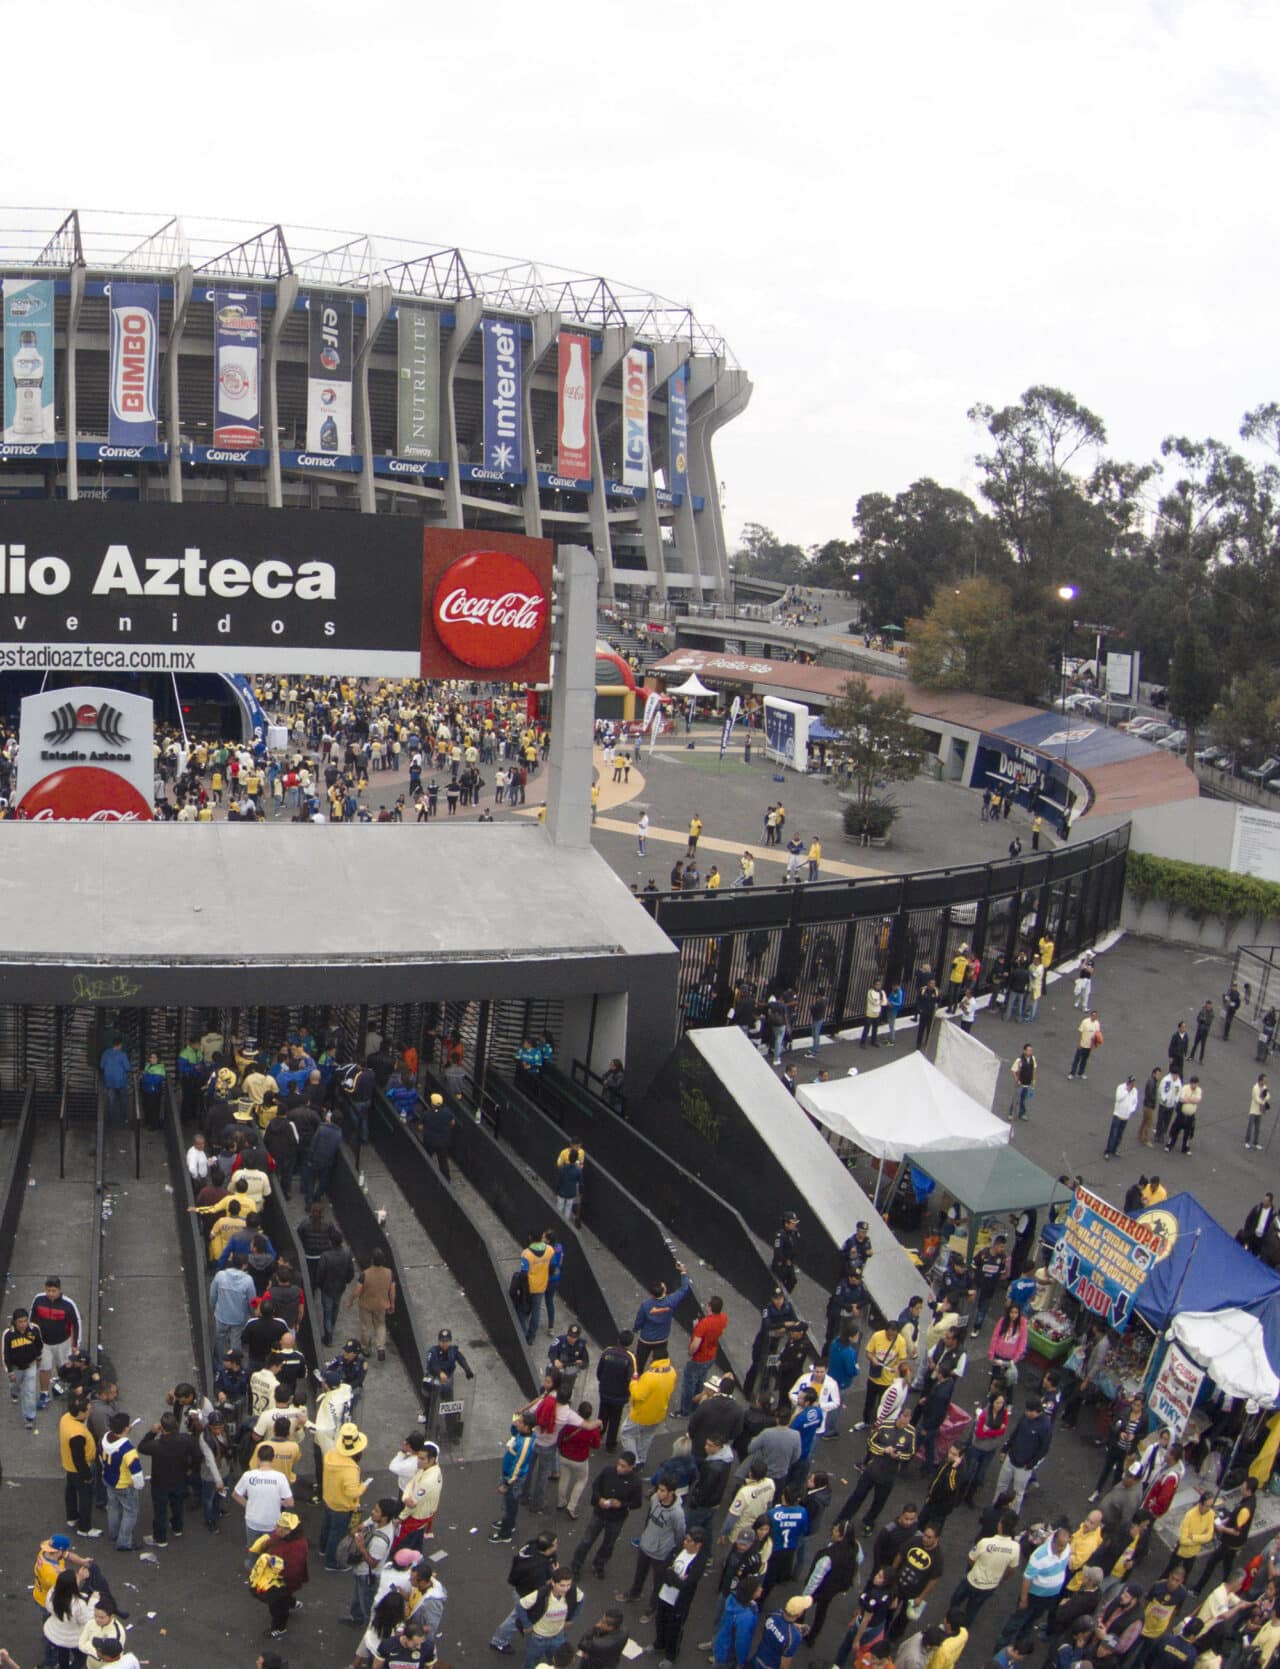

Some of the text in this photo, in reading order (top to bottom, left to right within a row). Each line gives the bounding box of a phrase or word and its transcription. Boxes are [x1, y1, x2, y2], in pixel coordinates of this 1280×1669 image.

[122, 314, 146, 413] BIMBO
[413, 316, 426, 439] NUTRILITE
[98, 445, 146, 458] Comex
[206, 449, 250, 462] Comex
[297, 454, 339, 467] Comex
[389, 460, 429, 473] Comex
[471, 467, 505, 481] Comex
[547, 474, 578, 488] Comex
[611, 483, 636, 496] Comex
[91, 544, 337, 600] Azteca
[439, 588, 544, 629] Coca-Cola
[41, 750, 132, 762] Estadio Azteca
[1076, 1277, 1113, 1317] AQUI
[248, 1475, 278, 1487] Corona
[773, 1511, 803, 1521] Corona
[781, 1529, 791, 1549] 1
[986, 1543, 1013, 1554] Corona
